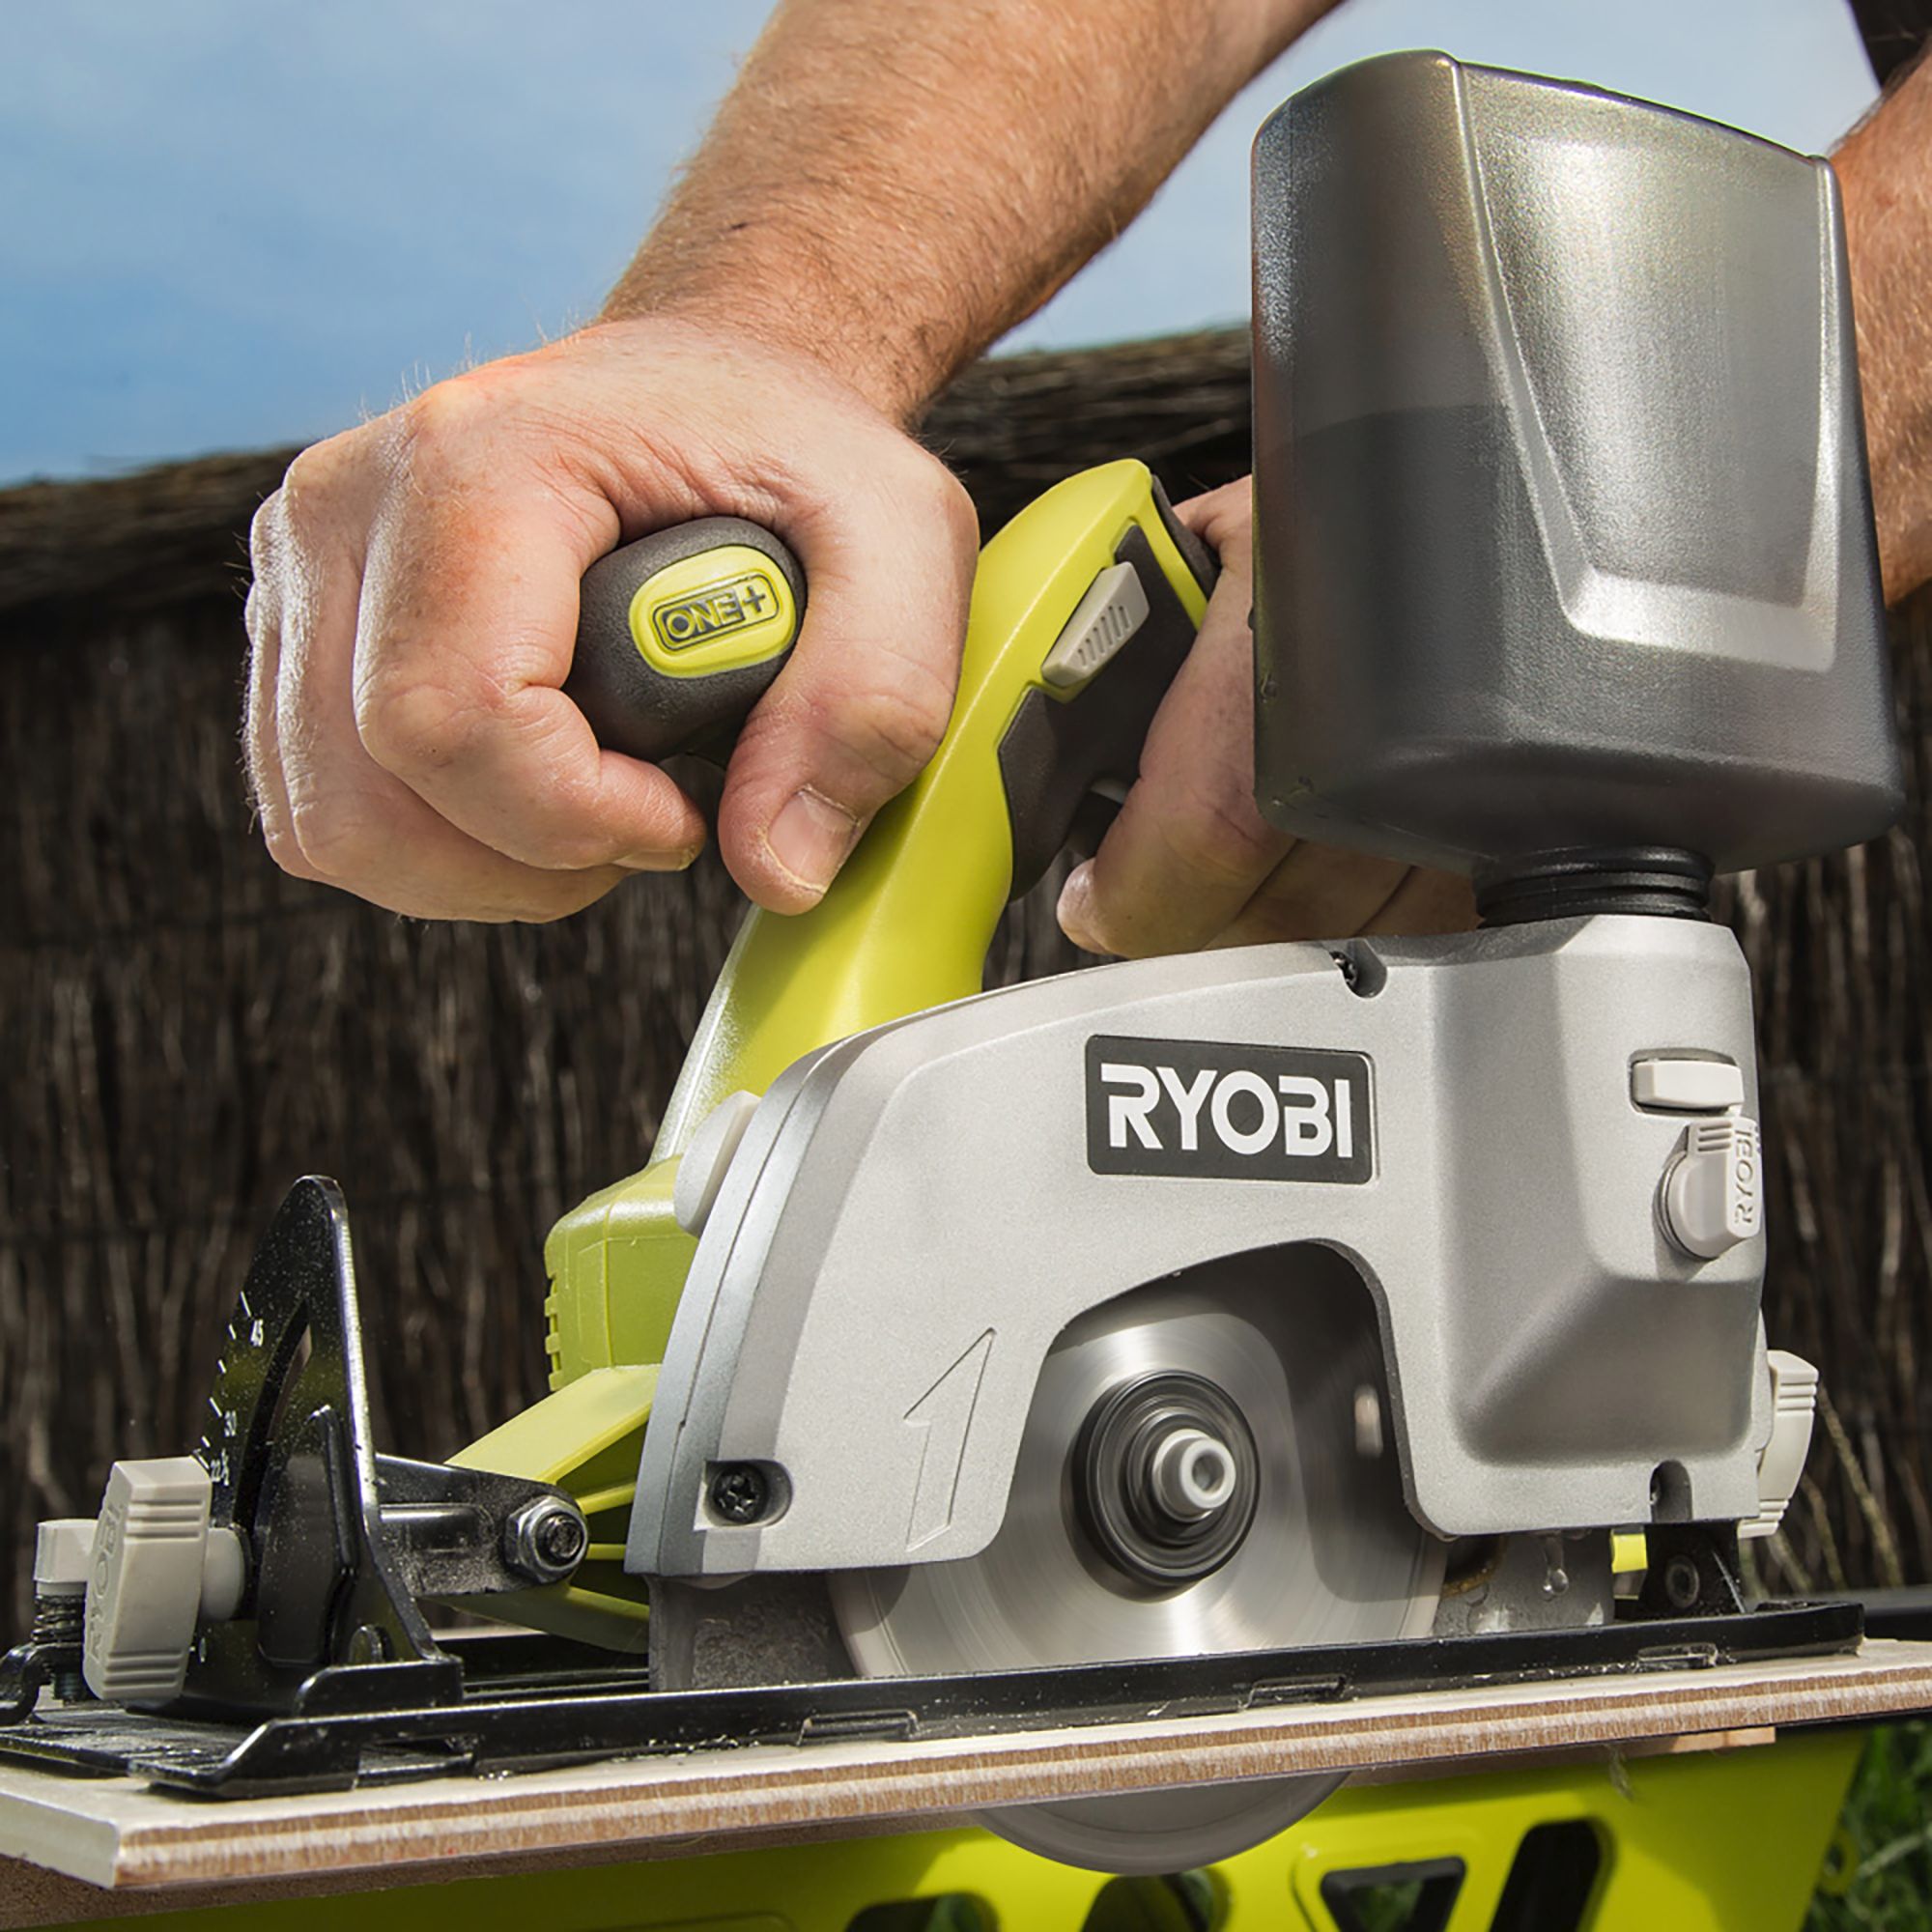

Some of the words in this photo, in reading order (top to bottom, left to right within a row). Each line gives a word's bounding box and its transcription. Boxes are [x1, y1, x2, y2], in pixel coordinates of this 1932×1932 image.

[661, 585, 766, 639] ONE+
[1100, 1062, 1353, 1158] RYOBI
[1735, 1129, 1753, 1224] RYOBI
